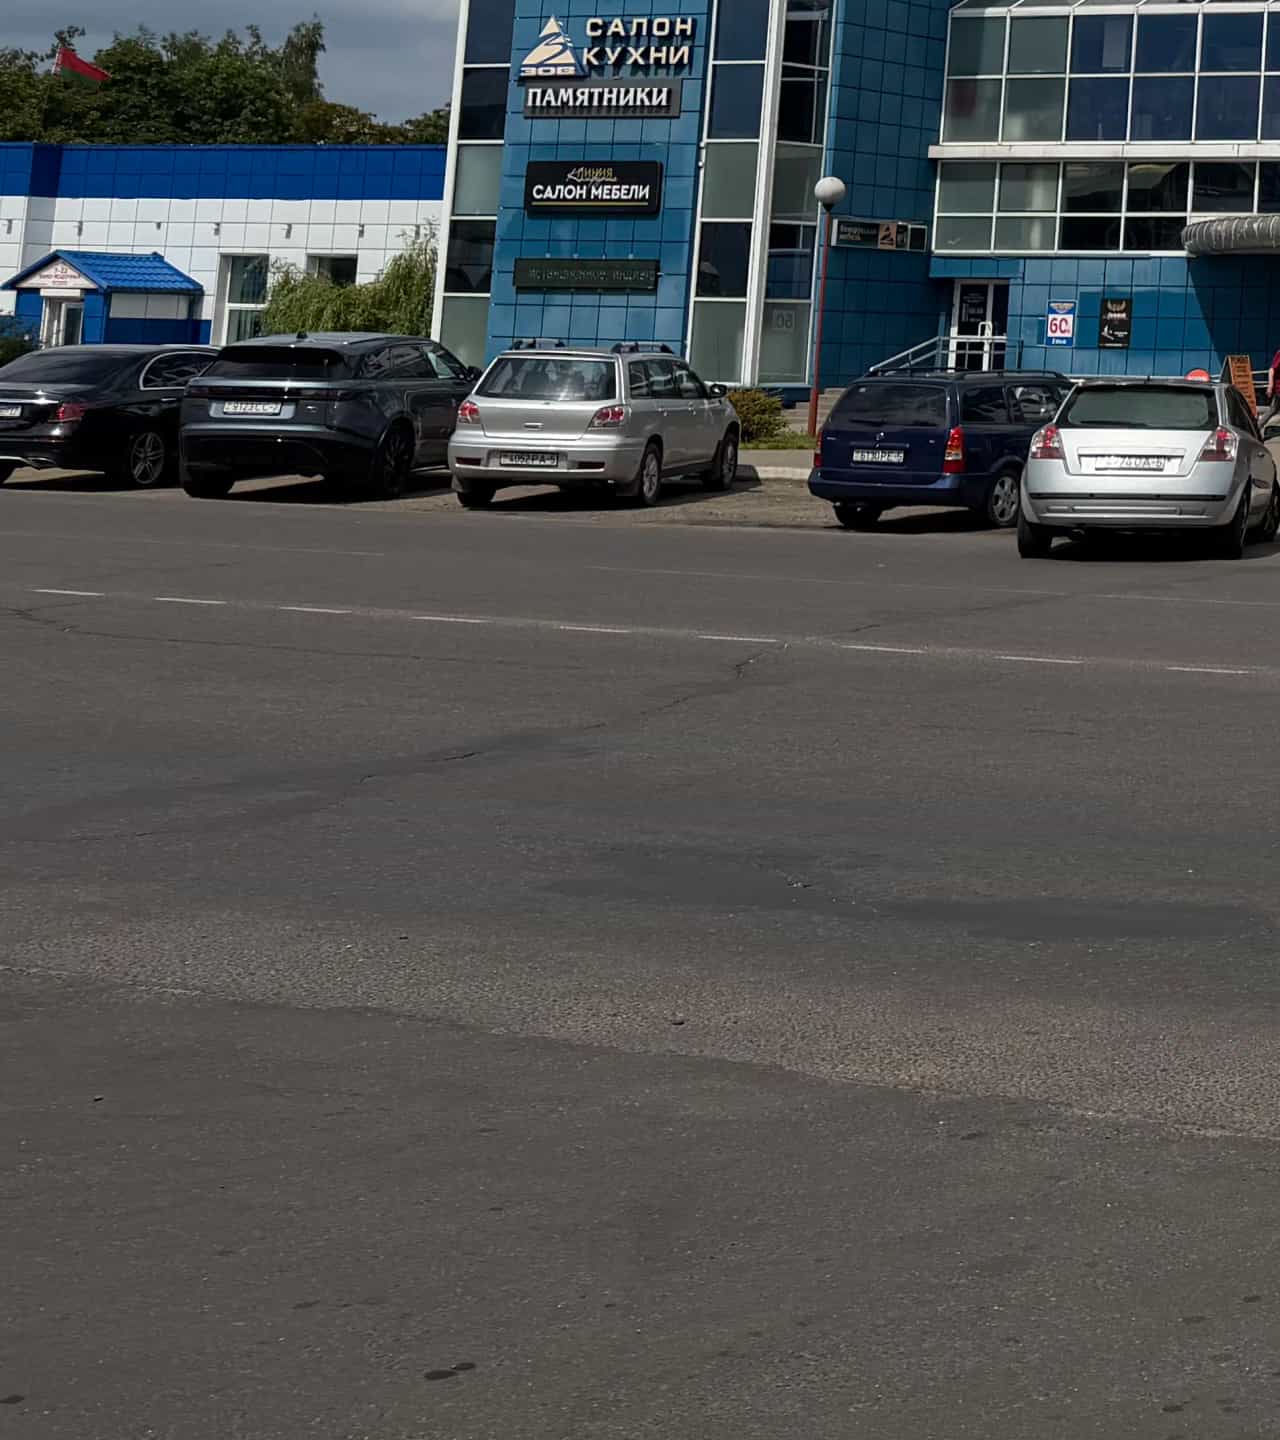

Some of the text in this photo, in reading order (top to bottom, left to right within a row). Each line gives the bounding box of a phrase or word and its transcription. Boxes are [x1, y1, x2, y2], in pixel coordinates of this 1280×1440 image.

[585, 17, 693, 37] САЛОН
[582, 46, 690, 66] КУХНИ
[526, 87, 669, 107] ПАМЯТНИКИ
[532, 184, 650, 200] САЛОН МЕБЕЛИ
